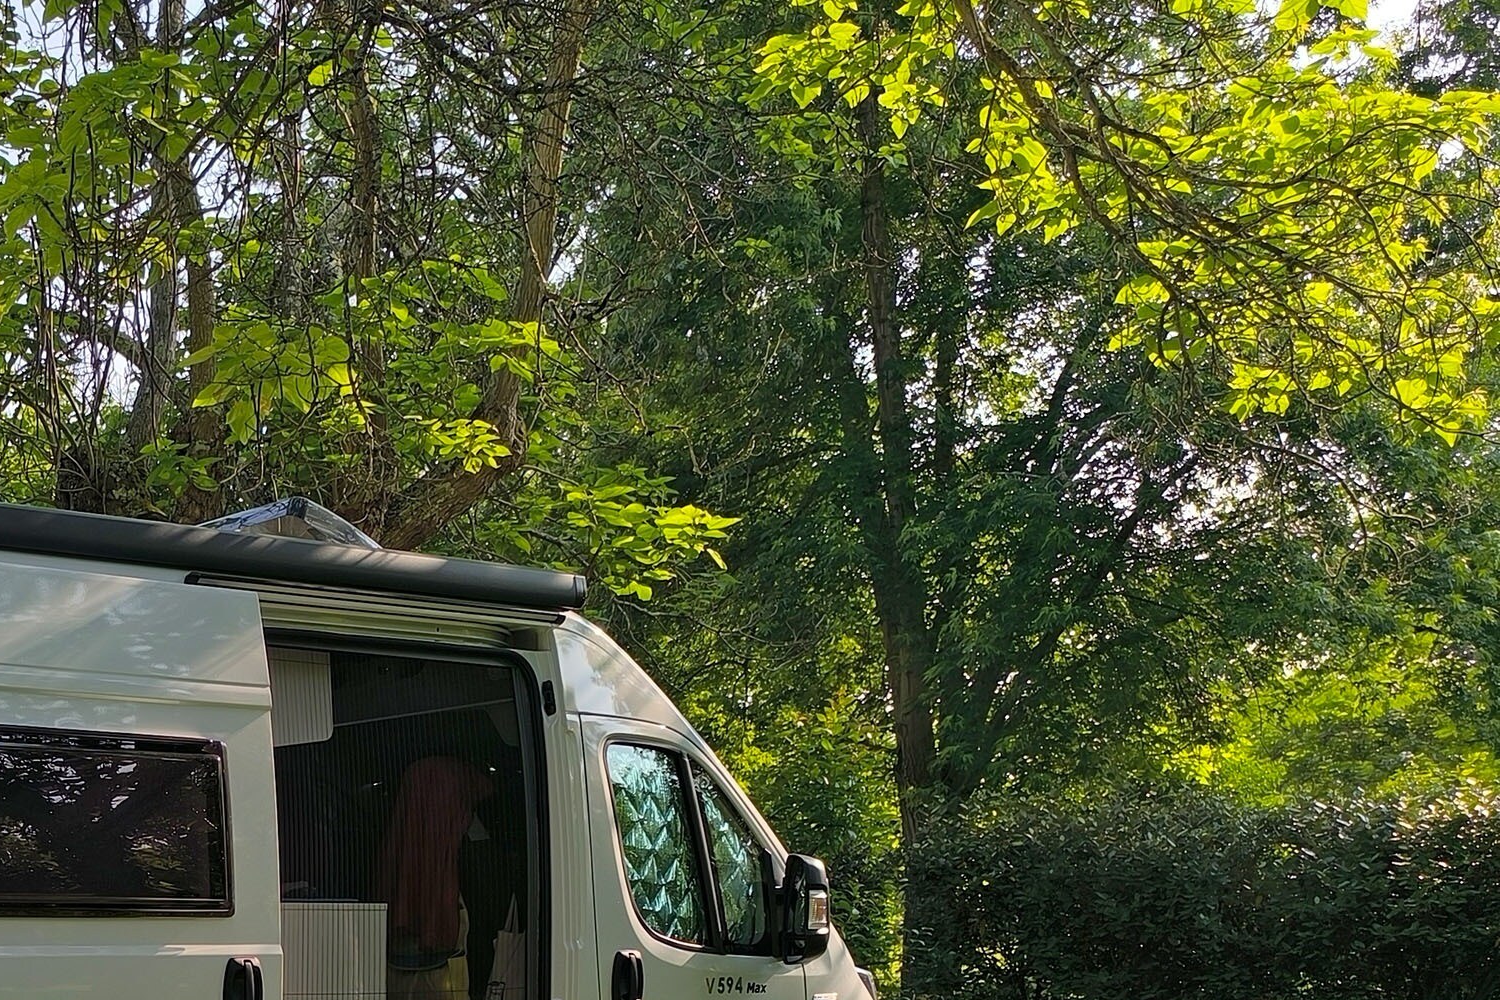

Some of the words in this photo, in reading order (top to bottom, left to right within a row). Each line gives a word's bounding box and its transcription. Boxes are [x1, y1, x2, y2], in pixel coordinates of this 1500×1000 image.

[705, 977, 716, 994] V
[717, 976, 743, 994] 594
[746, 982, 767, 994] Max
